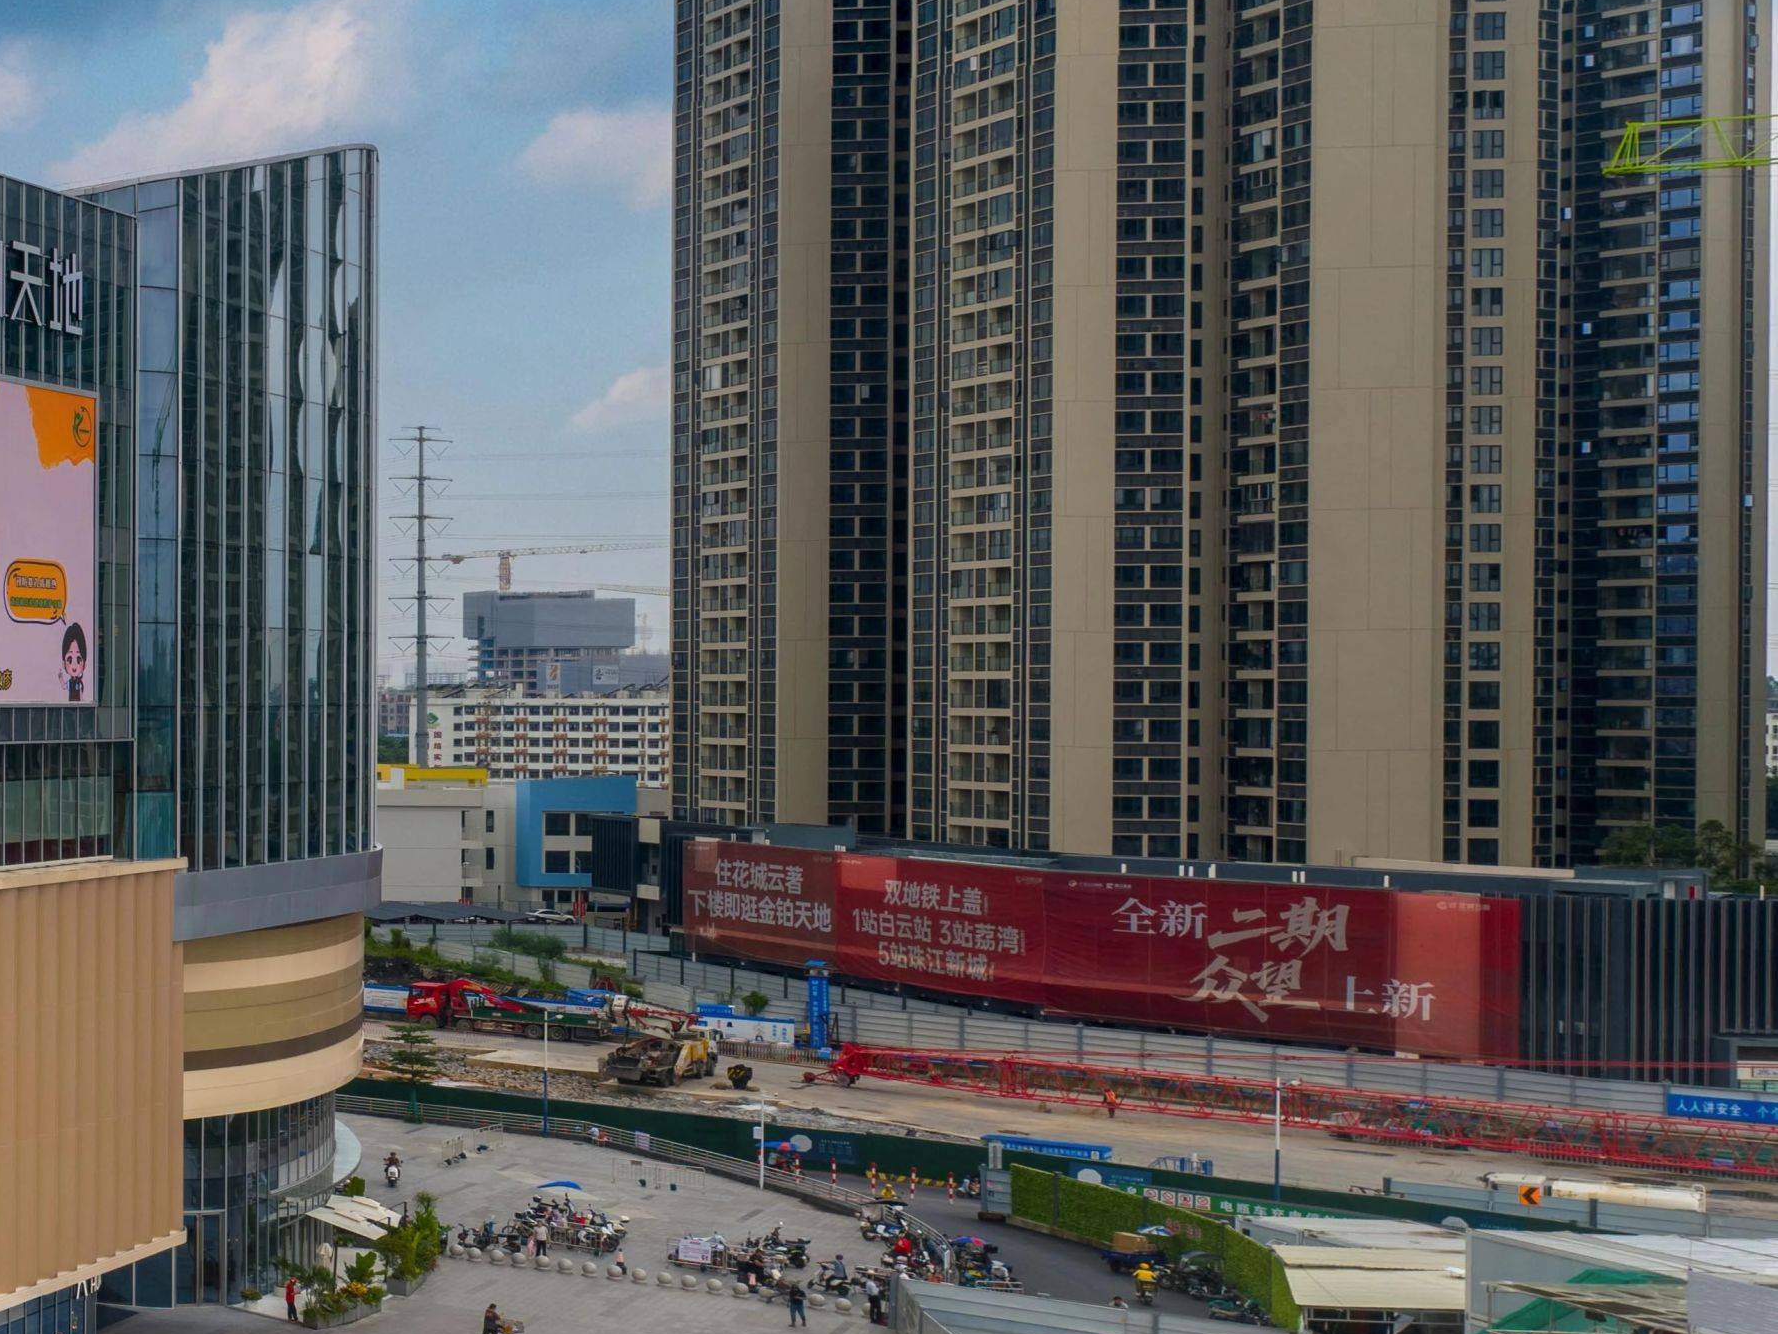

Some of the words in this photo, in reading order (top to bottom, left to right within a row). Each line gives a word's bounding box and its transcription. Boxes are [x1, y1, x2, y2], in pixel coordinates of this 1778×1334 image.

[884, 879, 983, 915] 双地铁上盖
[852, 908, 932, 943] 1站白云站
[1111, 896, 1208, 939] 全新
[1208, 896, 1349, 957] 二期
[878, 941, 988, 982] 5站珠江新城
[1172, 955, 1320, 1022] 众望
[1346, 976, 1436, 1020] 上新
